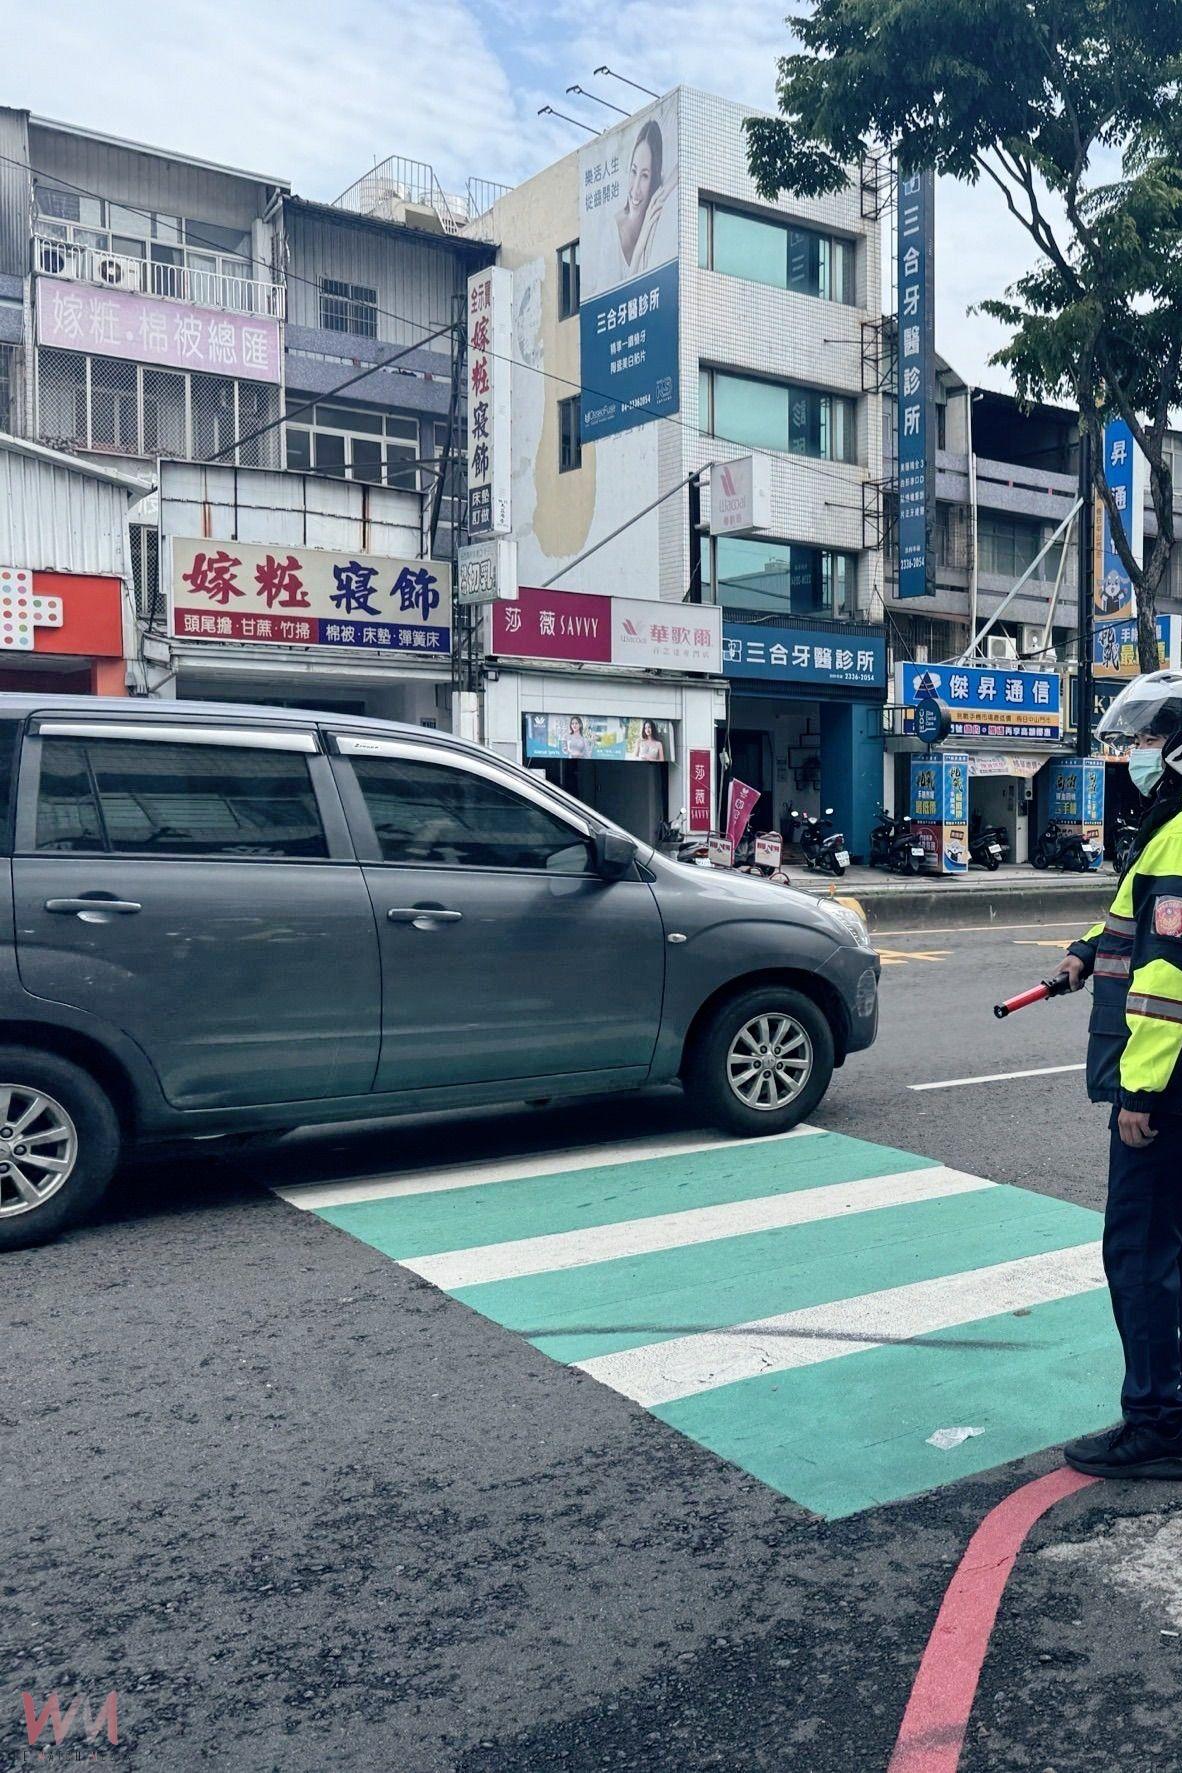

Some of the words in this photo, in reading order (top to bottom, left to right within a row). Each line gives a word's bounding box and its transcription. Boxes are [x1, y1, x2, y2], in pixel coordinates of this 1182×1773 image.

[597, 288, 659, 334] 三合牙醫診所
[903, 204, 920, 436] 三合牙醫診所
[505, 607, 555, 636] 莎薇
[560, 613, 598, 639] SAVVY
[650, 624, 711, 647] 華歌爾
[746, 642, 874, 673] 三合牙醫診所
[950, 675, 1050, 704] 傑昇通信
